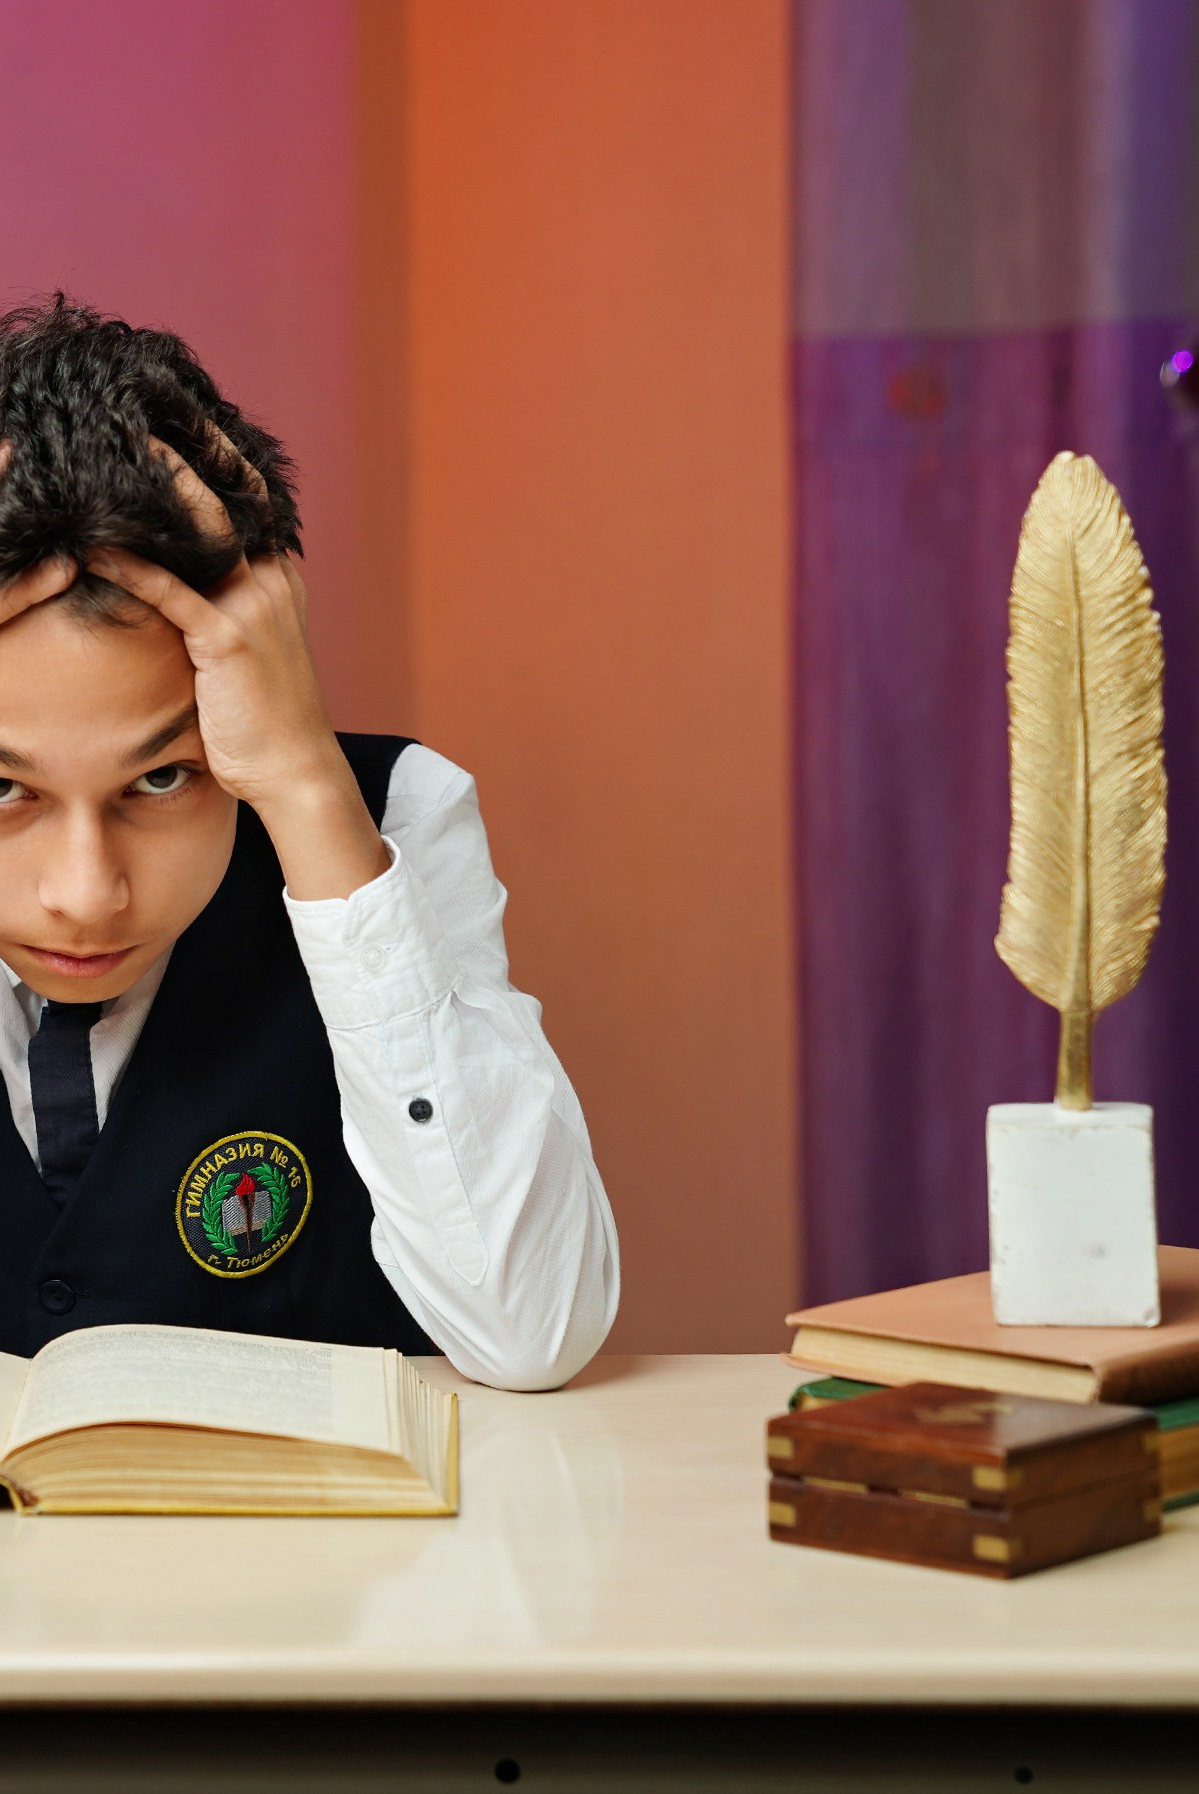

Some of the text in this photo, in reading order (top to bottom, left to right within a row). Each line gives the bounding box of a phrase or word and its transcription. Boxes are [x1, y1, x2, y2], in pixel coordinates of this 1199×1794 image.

[186, 1143, 301, 1218] ГИМНАЗИЯ № 16
[227, 1234, 289, 1269] Тюмень
